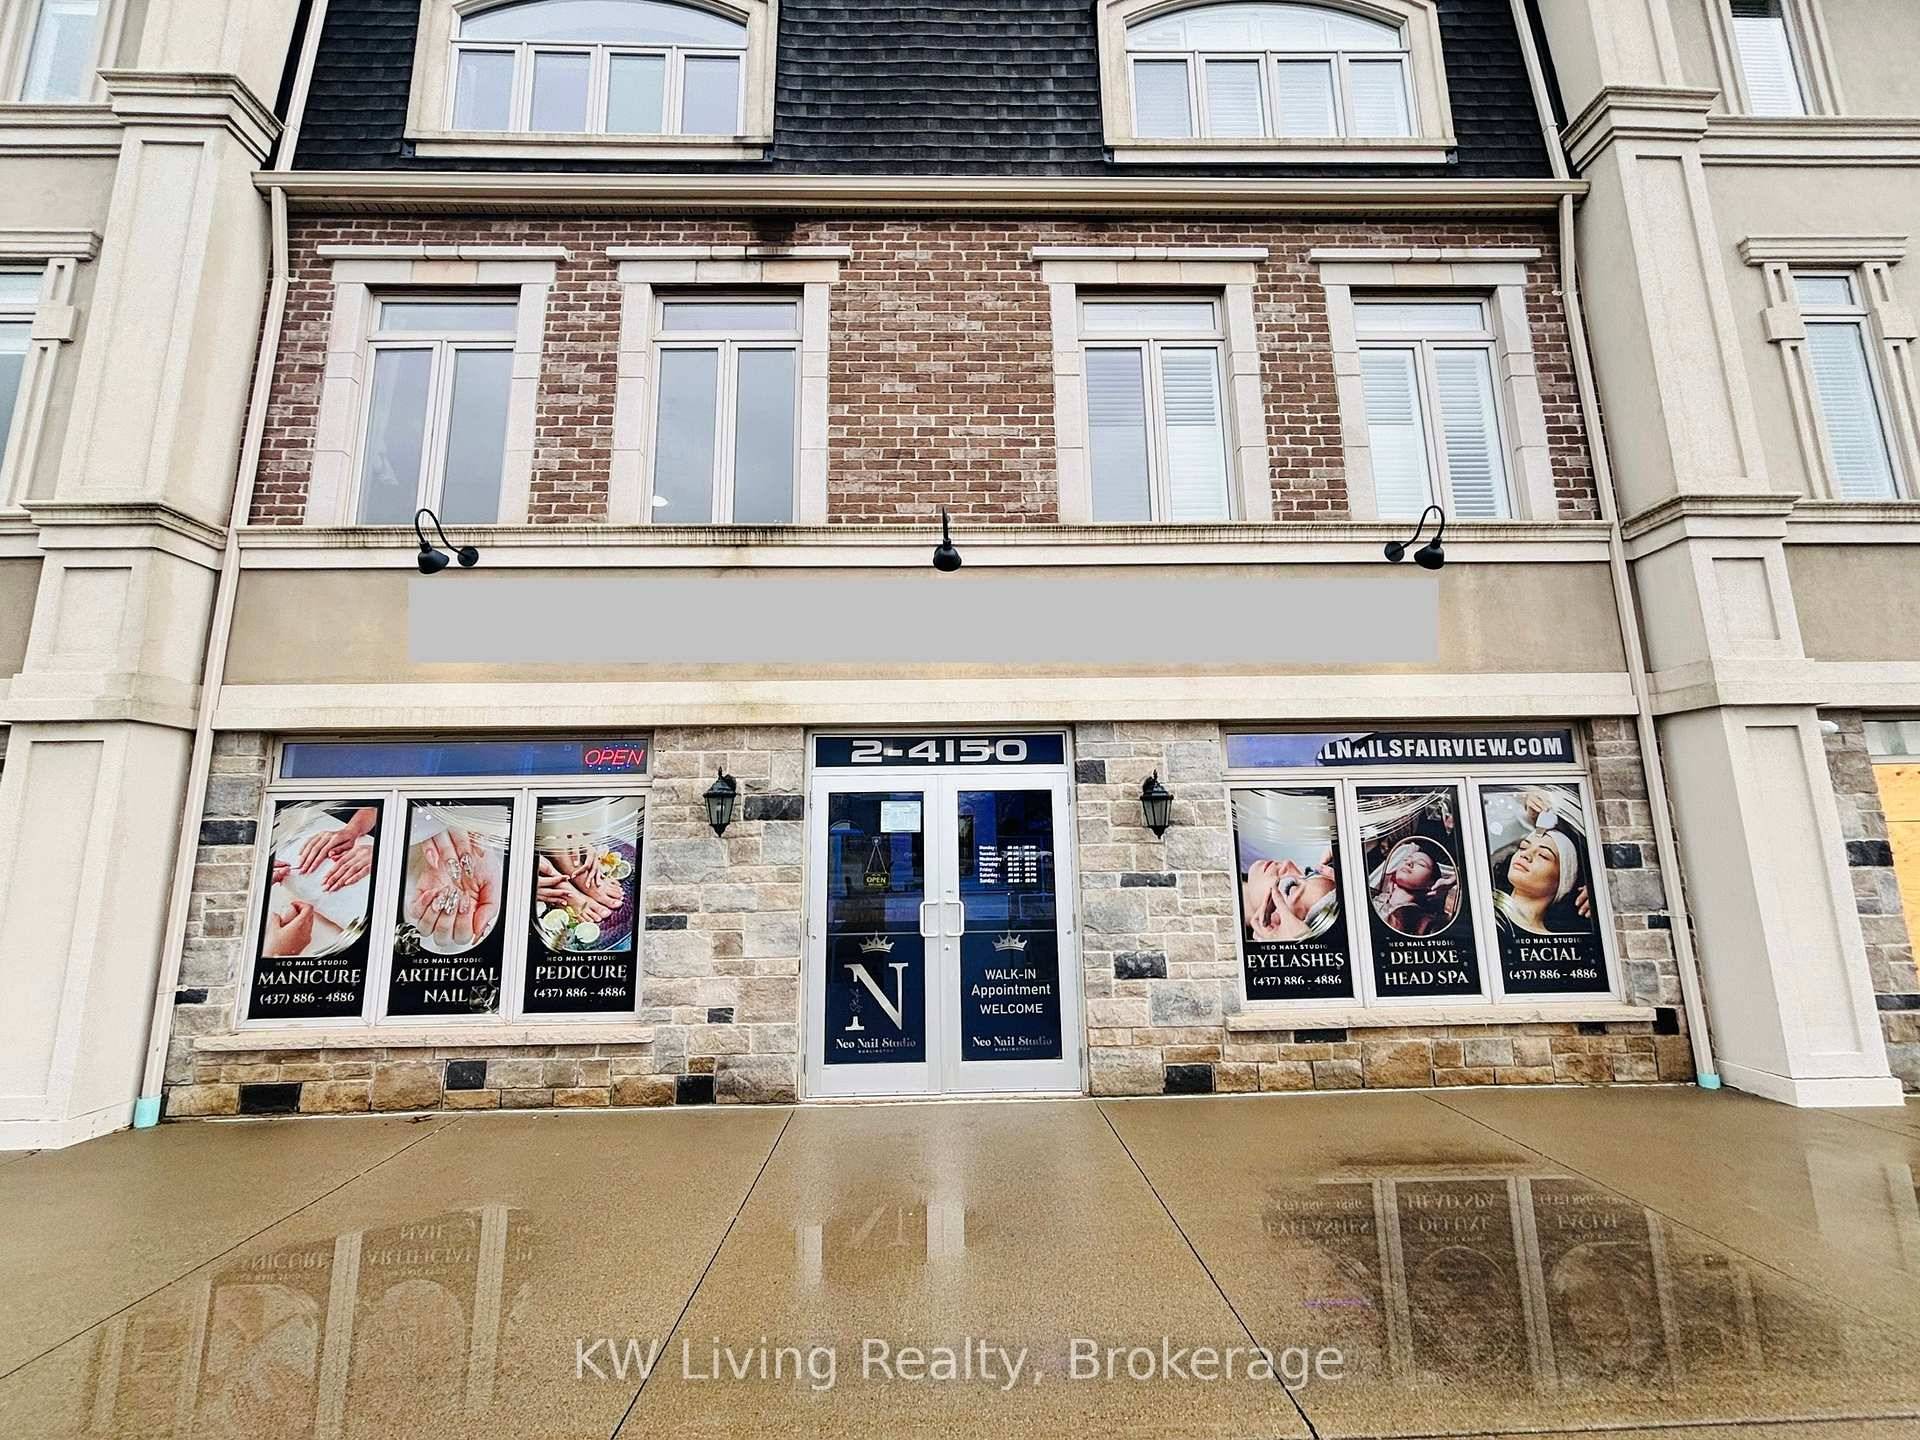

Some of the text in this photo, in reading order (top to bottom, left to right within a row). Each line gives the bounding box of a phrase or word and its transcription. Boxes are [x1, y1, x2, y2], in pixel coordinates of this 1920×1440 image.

[584, 748, 644, 766] OPEN
[851, 739, 1027, 763] 2-4150
[1247, 952, 1345, 968] EYELASHES
[1390, 949, 1459, 965] DELUXE
[1520, 947, 1582, 962] FACIAL
[257, 968, 361, 985] MANICURE
[395, 967, 499, 982] ARTIFICIAL
[535, 964, 628, 980] PEDICURE
[984, 968, 1036, 980] WALK-IN
[1384, 970, 1470, 986] HEAD SPA
[1509, 969, 1537, 980] (437)
[1540, 969, 1561, 979] 886
[1569, 968, 1598, 979] 4886
[1253, 976, 1282, 986] (437)
[1284, 976, 1305, 985] 886
[1314, 974, 1342, 985] 4886
[260, 994, 290, 1005] (437)
[292, 993, 315, 1003] 886
[325, 991, 355, 1002] 4886
[423, 989, 469, 1003] NAIL
[533, 988, 563, 998] (437)
[565, 988, 588, 998] 886
[597, 986, 627, 997] 4886
[971, 983, 1052, 999] Appointment
[980, 1003, 1044, 1014] WELCOME
[835, 1037, 917, 1049] Neo Nail Studio
[972, 1035, 1053, 1047] Neo Nail Studio
